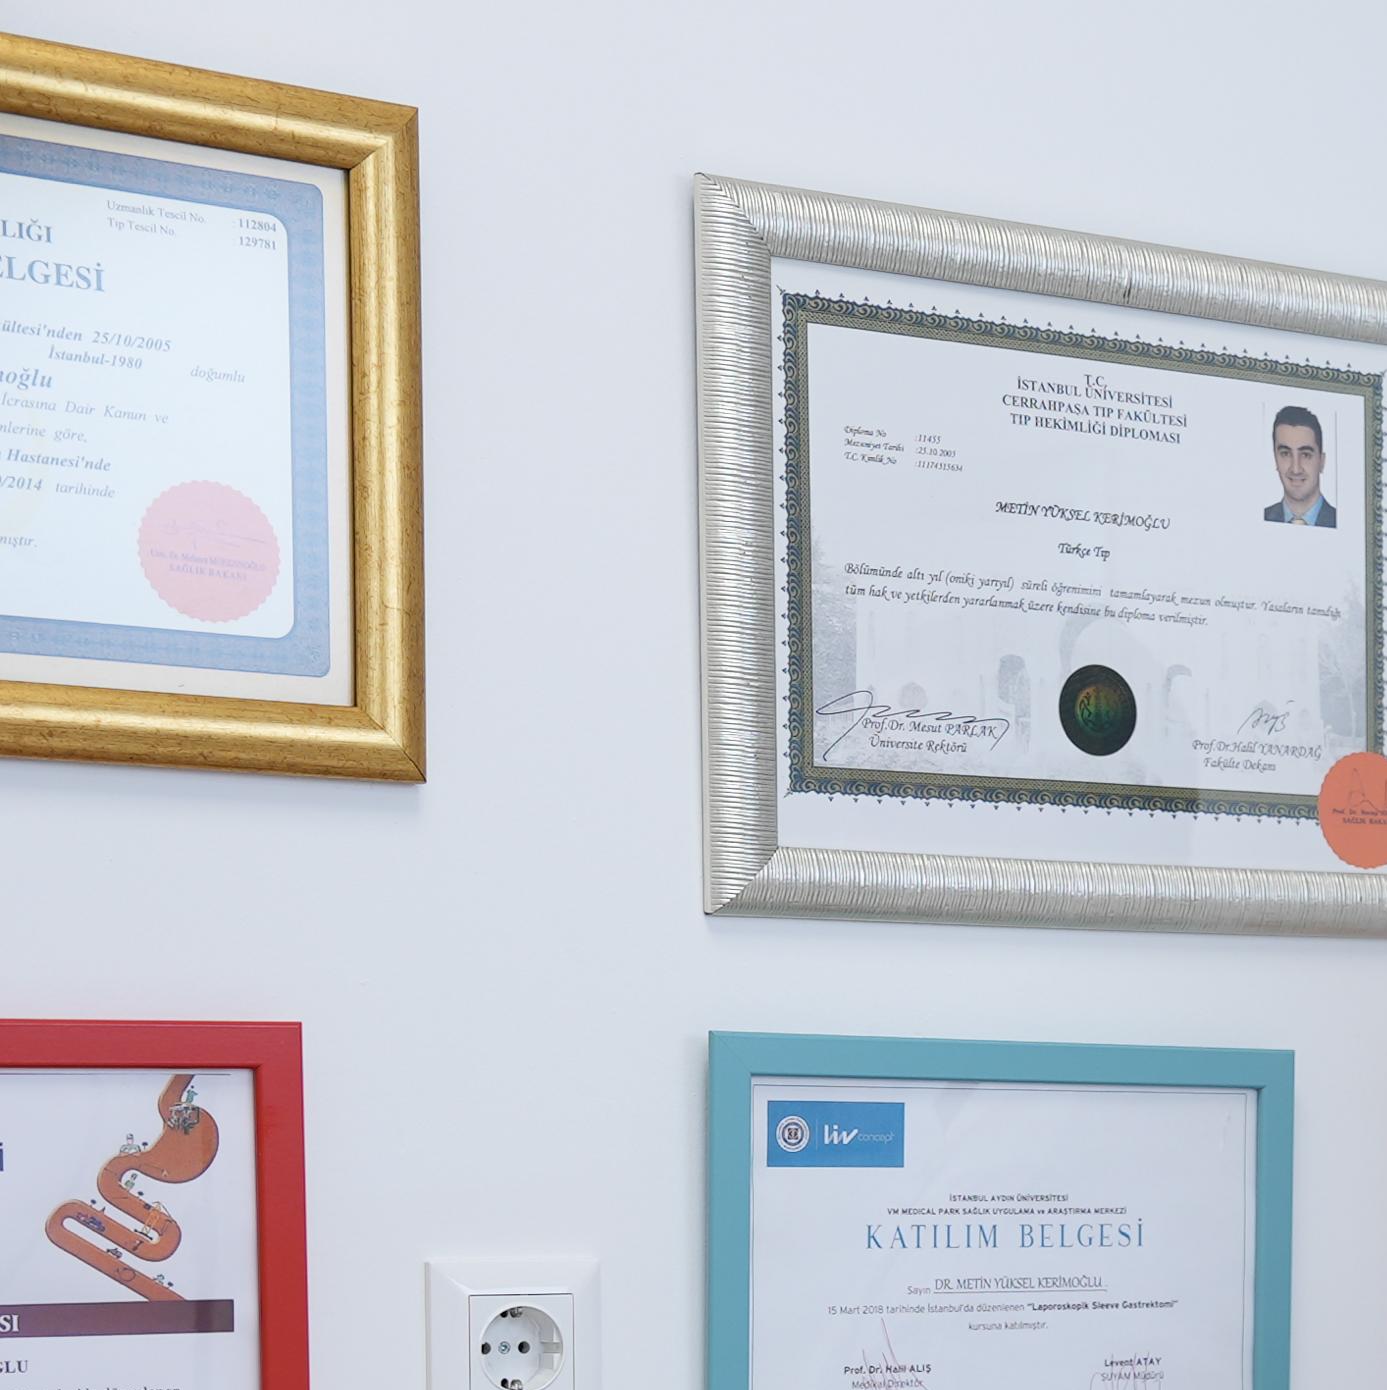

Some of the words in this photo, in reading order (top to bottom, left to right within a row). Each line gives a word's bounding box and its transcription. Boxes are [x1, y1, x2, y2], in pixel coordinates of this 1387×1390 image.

[106, 200, 154, 216] Uzmanlık
[156, 207, 187, 222] Tescil
[189, 212, 206, 224] No.
[106, 216, 125, 231] Tıp
[128, 220, 157, 234] Tescil
[160, 224, 177, 237] No.
[238, 218, 277, 233] 112804
[238, 236, 277, 250] 129781
[0, 254, 105, 292] LGESİ
[91, 331, 172, 352] 25/10/2005
[48, 344, 143, 370] İstanbul-1980
[190, 365, 246, 384] doğumlu
[1017, 376, 1082, 398] İSTANBUL
[1084, 386, 1173, 409] ÜNİVERSİTESİ
[64, 400, 95, 416] Dair
[103, 404, 147, 422] Kanun
[153, 413, 169, 424] ve
[1002, 394, 1090, 416] CERRAHPAŞA
[1092, 406, 1114, 419] TIP
[1117, 408, 1188, 428] FAKÜLTESİ
[53, 428, 88, 443] göre,
[1010, 412, 1031, 426] TIP
[1034, 416, 1106, 436] HEKİMLİĞİ
[1110, 424, 1181, 444] DİPLOMASI
[7, 448, 111, 472] Hastanesi'nde
[55, 482, 116, 498] tarihinde
[995, 501, 1040, 517] METİN
[1041, 504, 1092, 522] YÜKSEL
[1093, 511, 1171, 532] KERİMOĞLU
[1058, 542, 1091, 558] Türkçe
[1093, 546, 1111, 562] Tıp
[844, 562, 904, 579] Bölümünde
[906, 566, 925, 581] altı
[928, 570, 945, 586] yıl
[945, 571, 976, 587] (oniki
[1020, 579, 1048, 592] süreli
[1050, 582, 1102, 598] öğrenimini
[1109, 588, 1180, 606] tamamlayarak
[1180, 594, 1212, 606] mezun
[1214, 596, 1257, 611] olmuştur.
[846, 584, 866, 596] tüm
[868, 585, 890, 600] hak
[890, 590, 902, 600] ve
[904, 589, 960, 605] yetkilerden
[962, 594, 1028, 612] yararlanmak
[1028, 600, 1054, 612] üzere
[1056, 602, 1102, 617] kendisine
[1104, 606, 1116, 618] bu
[1118, 606, 1156, 624] diploma
[1158, 612, 1208, 628] verilmiştir.
[908, 720, 942, 734] Mesut
[944, 722, 998, 740] PARLAK
[868, 734, 924, 750] Üniversite
[926, 738, 968, 755] Rektörü
[1258, 743, 1322, 761] YANARDAĞ
[1203, 756, 1240, 770] Fakülte
[949, 1194, 989, 1202] İSTANBUL
[990, 1194, 1015, 1202] AYDIN
[1016, 1192, 1069, 1202] ÜNİVERSİTESİ
[887, 1208, 900, 1216] VM
[938, 1208, 960, 1216] PARK
[962, 1206, 991, 1216] SAĞLIK
[992, 1207, 1035, 1216] UYGULAMA
[1047, 1207, 1092, 1216] ARAŞTIRMA
[1094, 1206, 1128, 1215] MERKEZİ
[866, 1224, 999, 1249] KATILIM
[1019, 1218, 1145, 1248] BELGESİ
[907, 1286, 932, 1296] Sayın
[956, 1276, 992, 1290] METİN
[994, 1276, 1035, 1289] YÜKSEL
[1038, 1274, 1102, 1288] KERİMOĞLU
[828, 1306, 837, 1315] 15
[840, 1306, 860, 1314] Mart
[862, 1304, 884, 1314] 2018
[886, 1304, 926, 1314] tarihinde
[976, 1302, 1025, 1312] düzenlenen
[1092, 1300, 1120, 1310] Sleeve
[968, 1321, 1002, 1330] kursuna
[1004, 1320, 1048, 1332] katılmıştır.
[844, 1366, 866, 1374] Prof.
[909, 1364, 932, 1374] ALIŞ
[1136, 1357, 1162, 1366] ATAY
